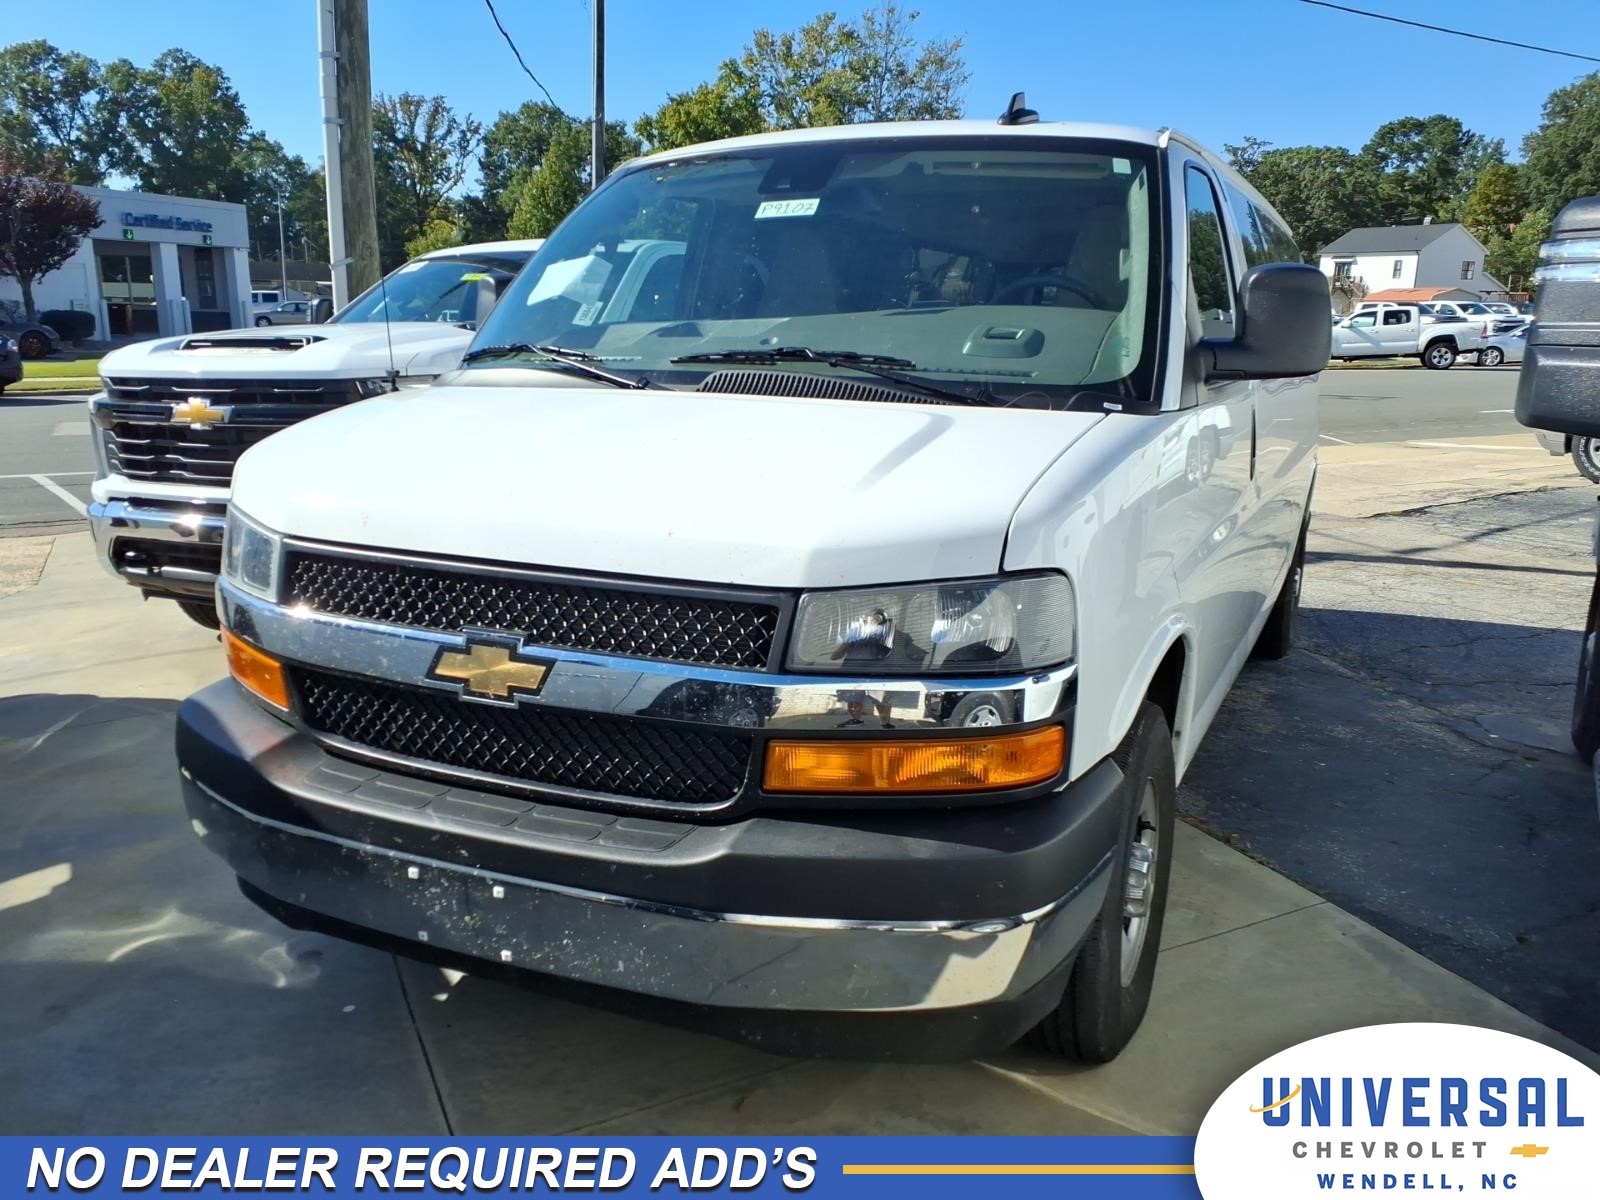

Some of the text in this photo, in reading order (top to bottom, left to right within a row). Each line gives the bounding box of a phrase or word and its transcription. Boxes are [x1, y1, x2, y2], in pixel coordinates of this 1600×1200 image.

[761, 202, 815, 215] P9107
[124, 211, 213, 233] Certified Service
